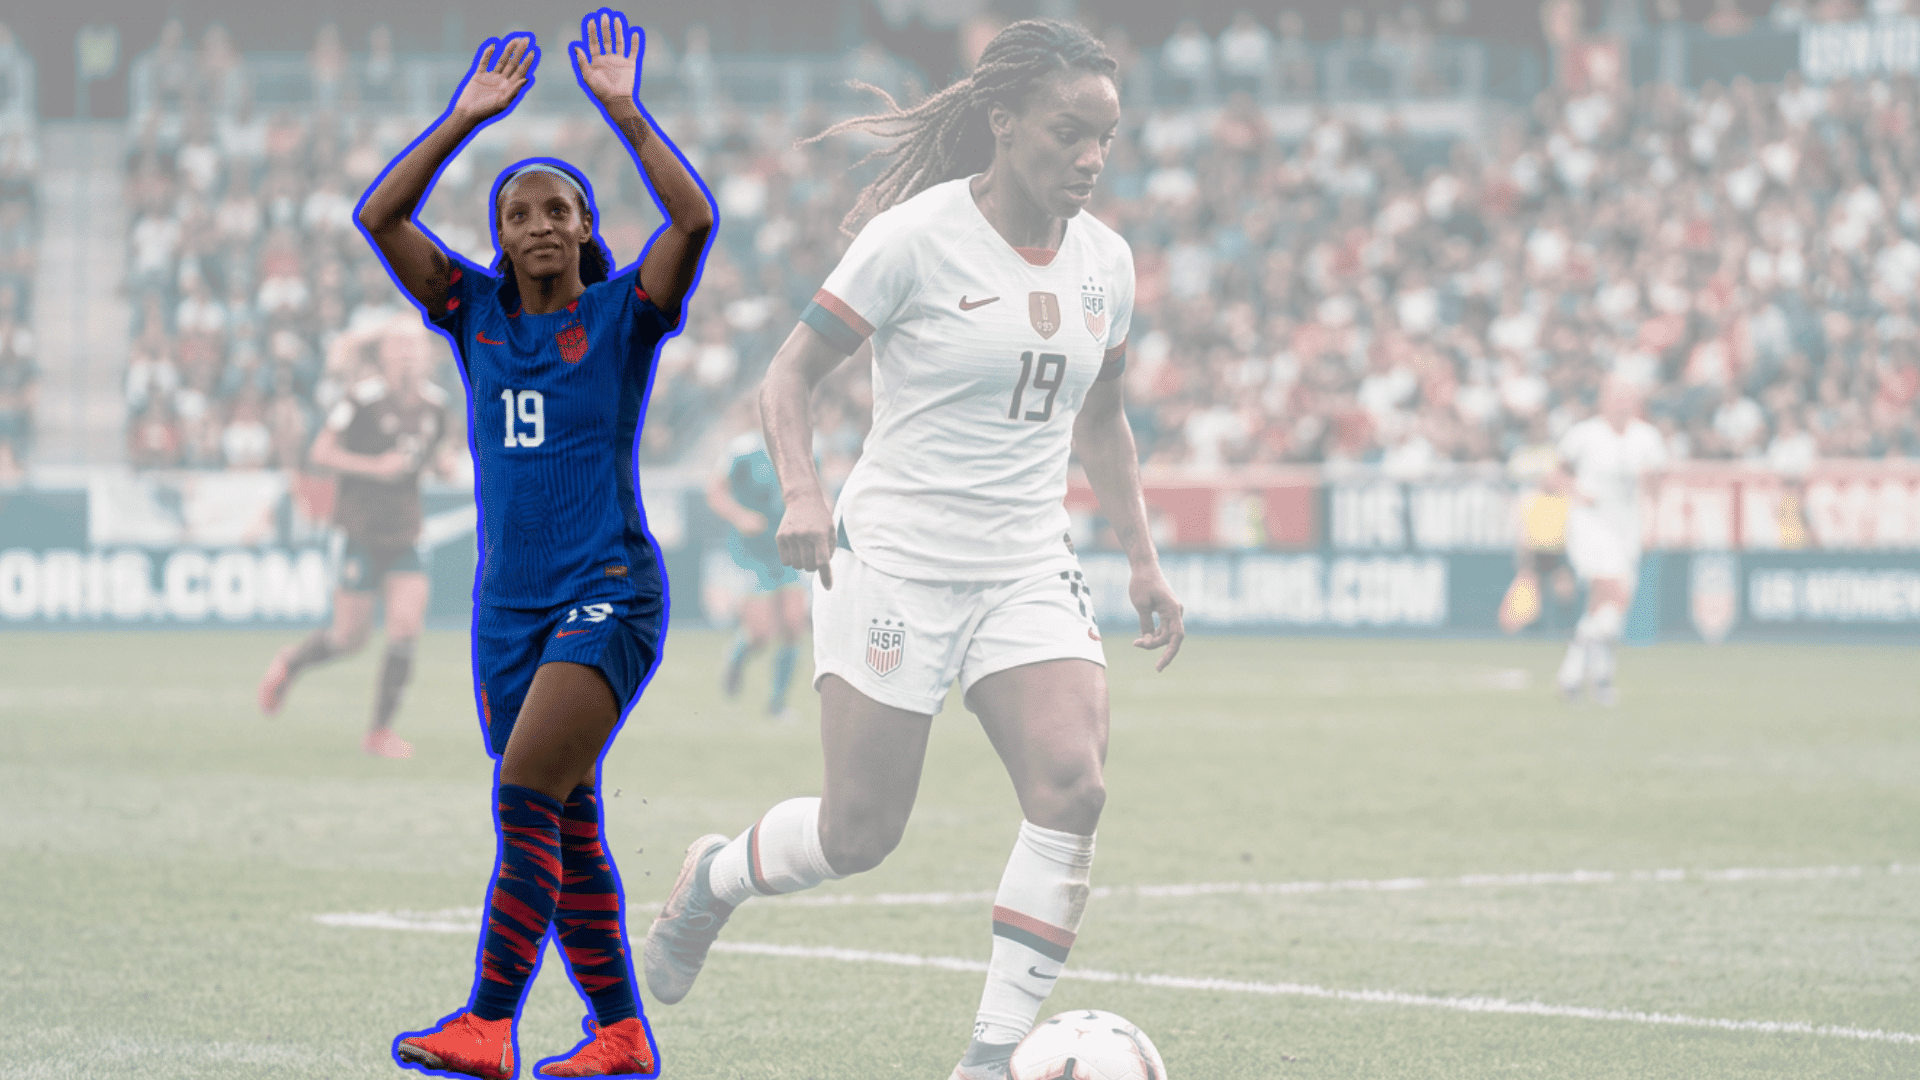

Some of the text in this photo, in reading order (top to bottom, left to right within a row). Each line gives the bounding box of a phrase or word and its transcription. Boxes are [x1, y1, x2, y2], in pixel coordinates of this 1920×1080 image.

[1008, 350, 1067, 422] 19
[501, 388, 545, 448] 19
[871, 631, 902, 650] USA
